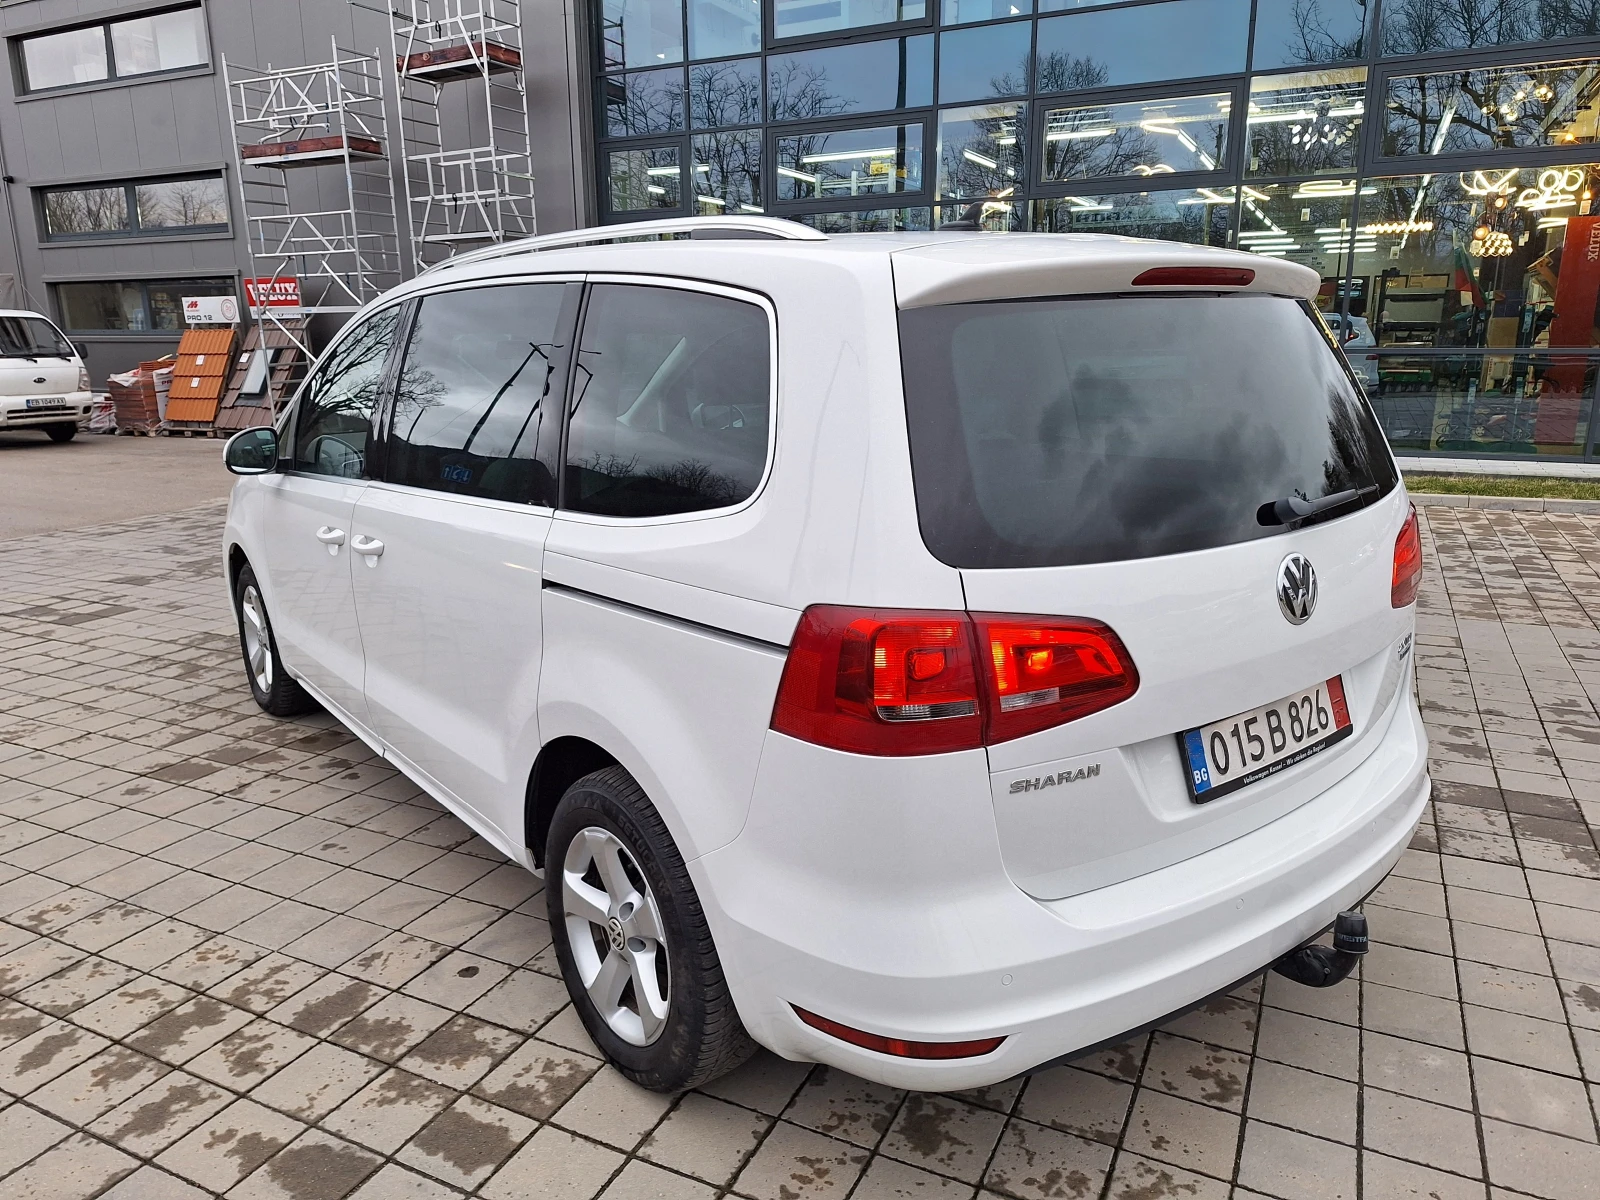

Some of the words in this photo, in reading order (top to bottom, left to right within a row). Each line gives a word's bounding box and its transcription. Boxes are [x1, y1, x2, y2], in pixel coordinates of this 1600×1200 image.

[1009, 763, 1101, 794] SHARAN
[1193, 767, 1208, 784] BG
[1243, 769, 1269, 784] Volkswagen
